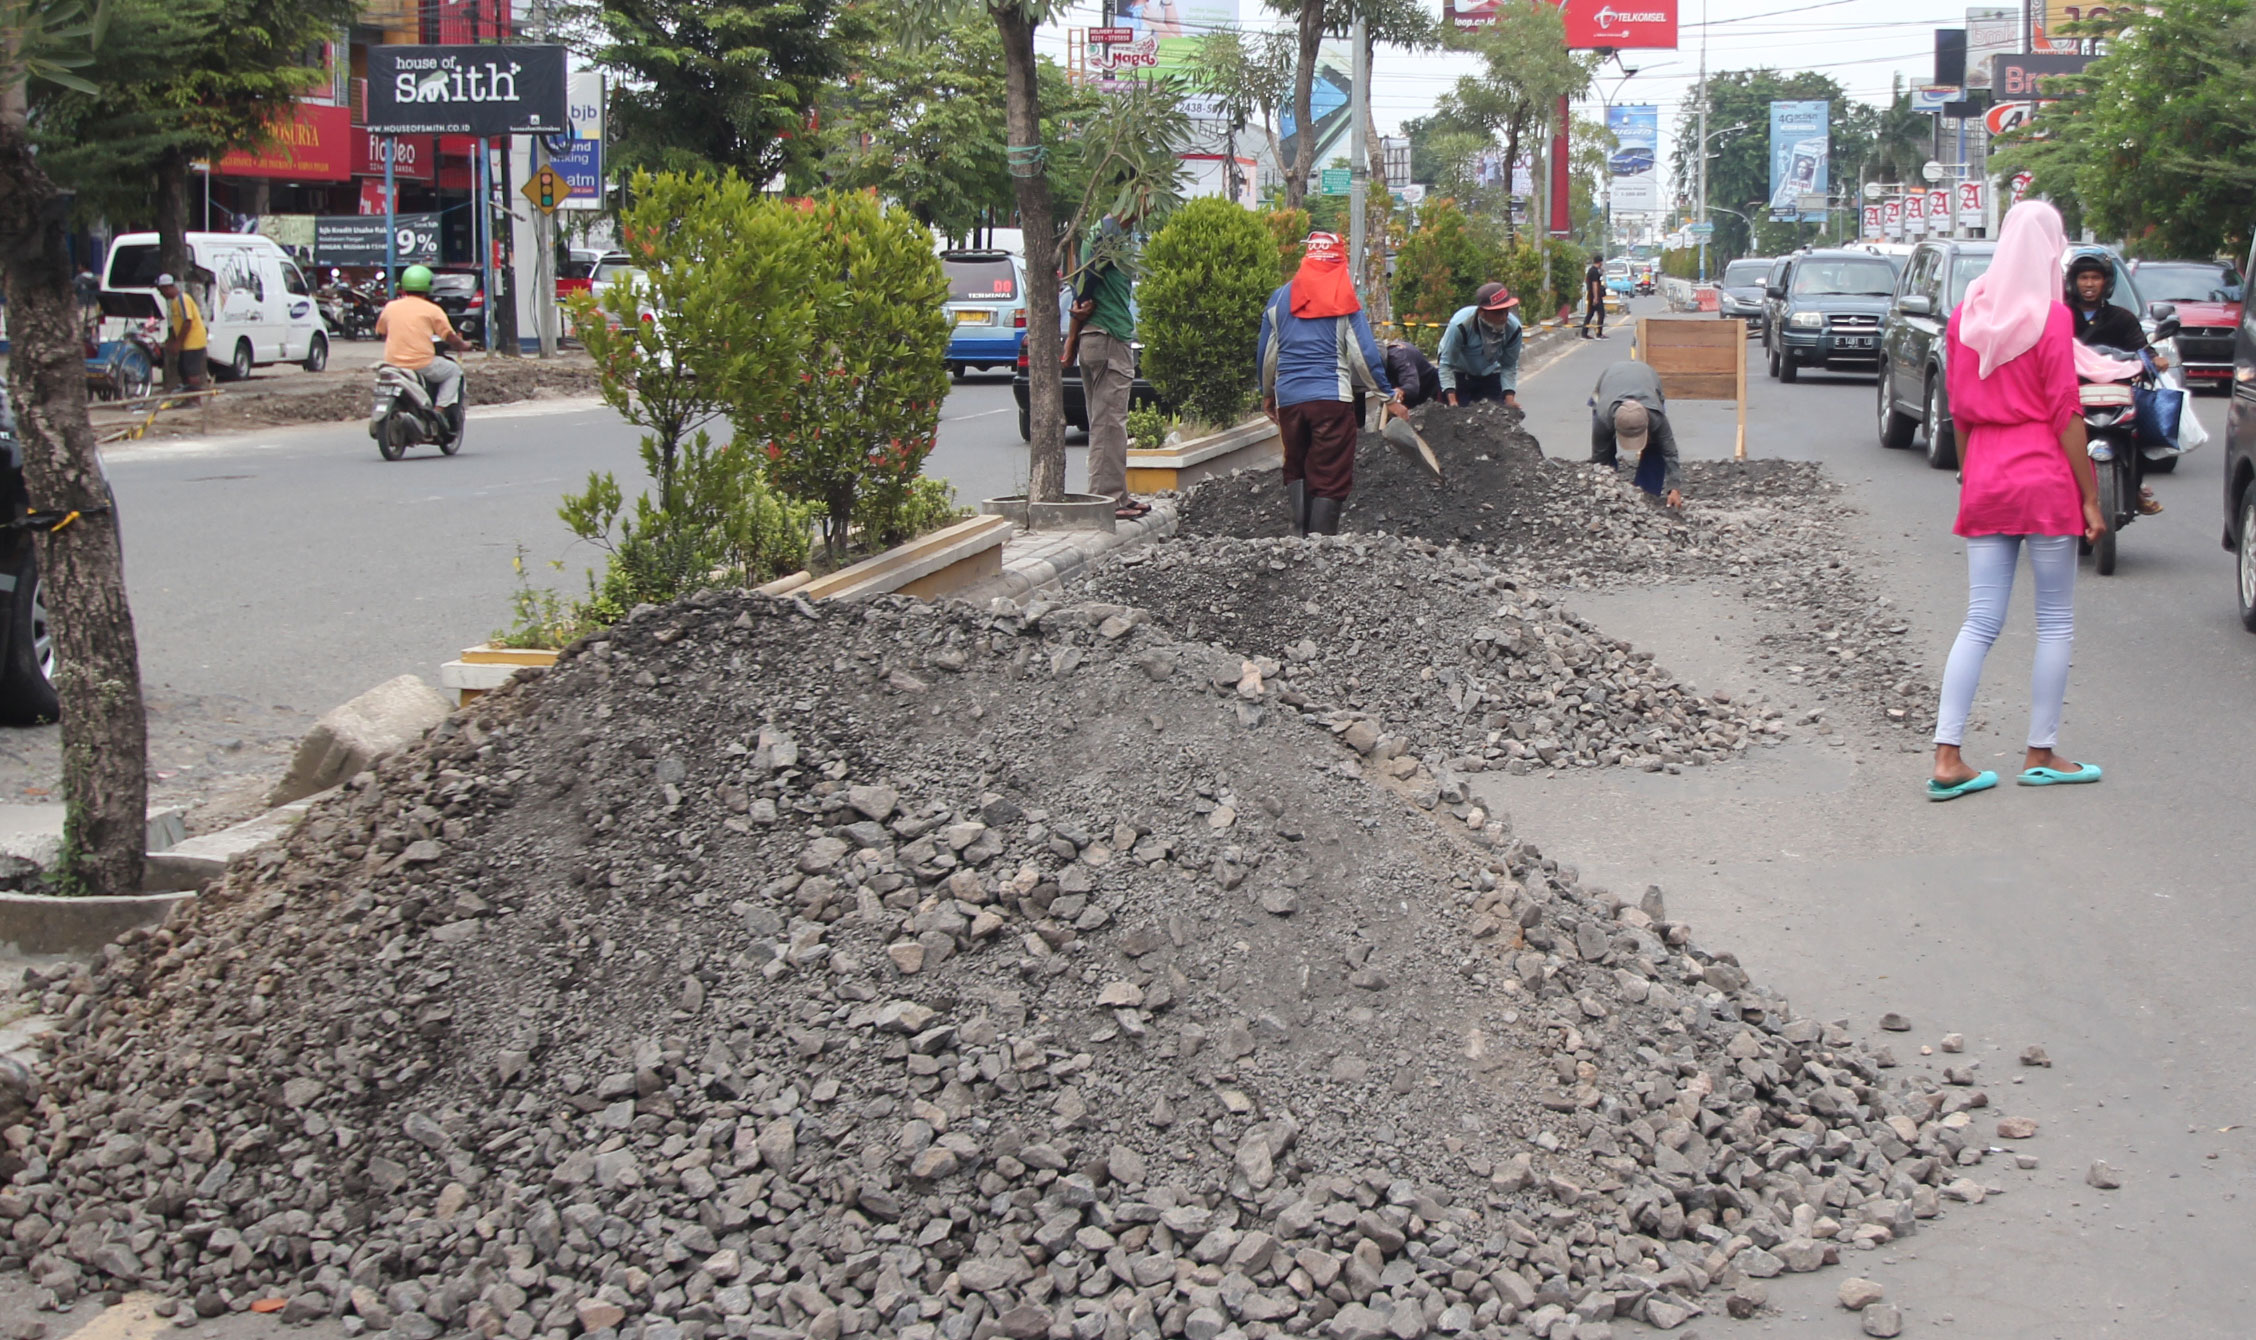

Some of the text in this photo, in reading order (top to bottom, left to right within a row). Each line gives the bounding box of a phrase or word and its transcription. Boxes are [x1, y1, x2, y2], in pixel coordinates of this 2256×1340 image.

[1617, 12, 1667, 23] TELKOMSEL
[395, 55, 457, 69] house of
[571, 104, 598, 122] bjb
[566, 173, 595, 187] atm
[397, 229, 438, 255] 9%
